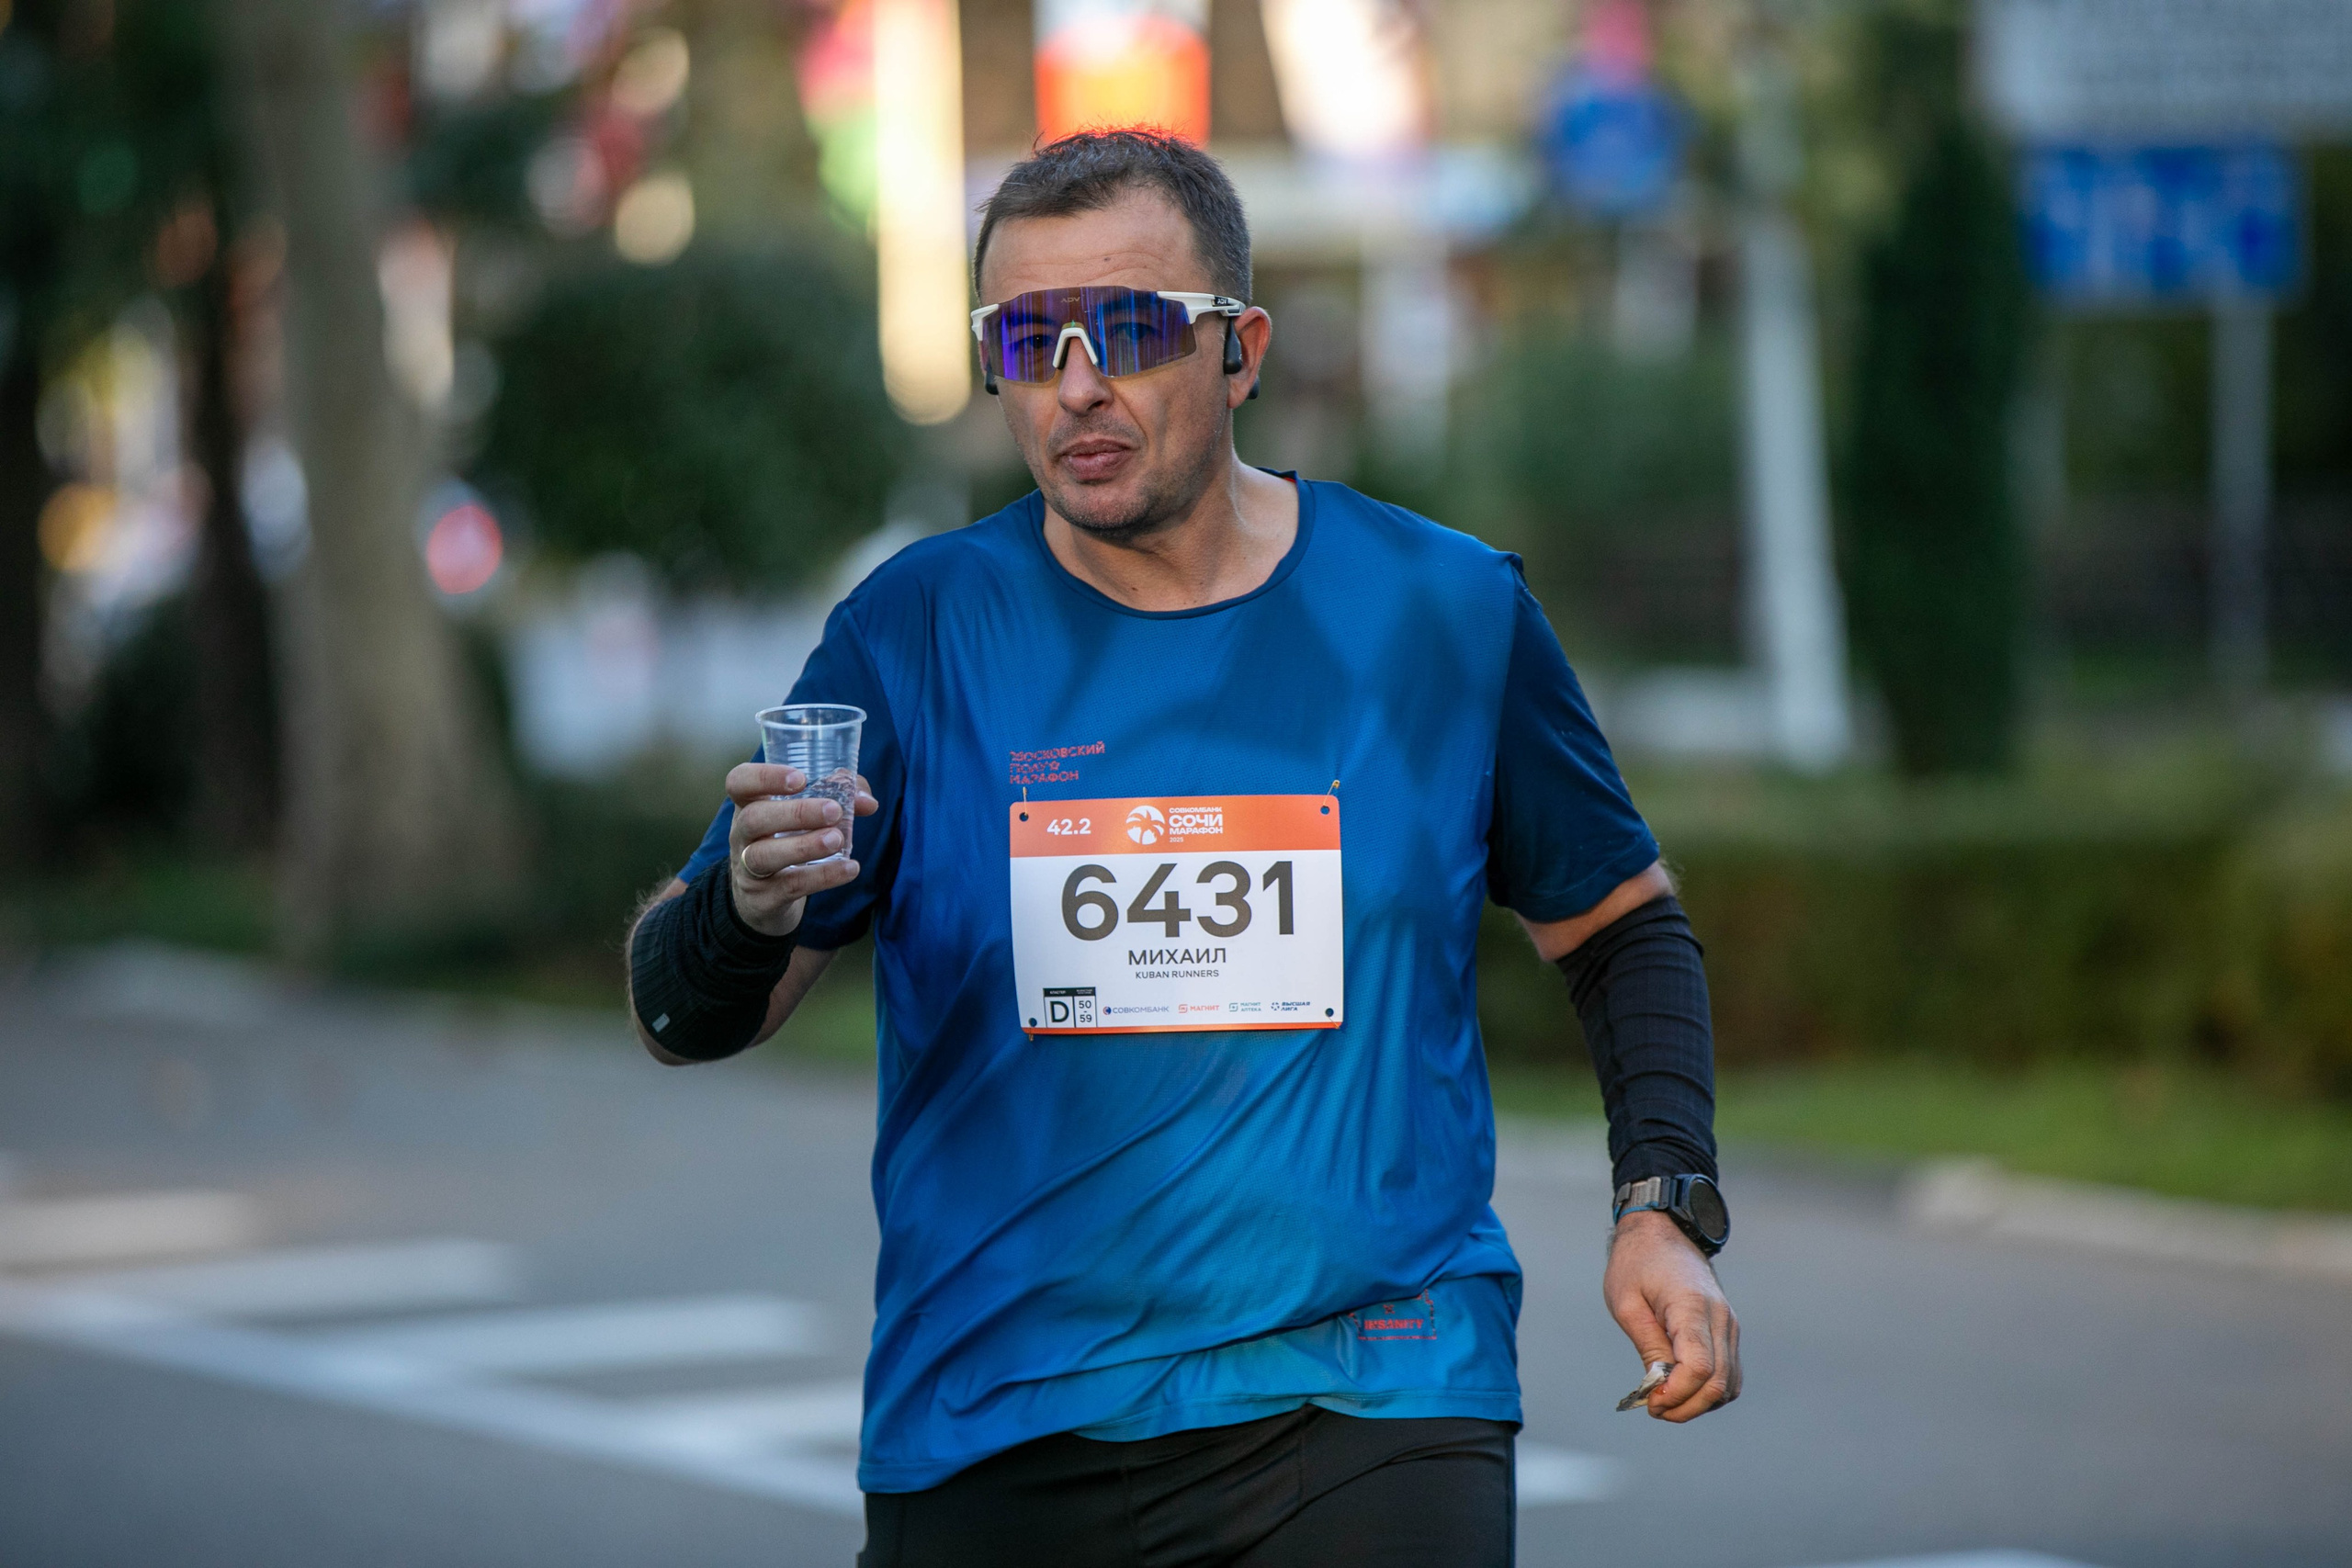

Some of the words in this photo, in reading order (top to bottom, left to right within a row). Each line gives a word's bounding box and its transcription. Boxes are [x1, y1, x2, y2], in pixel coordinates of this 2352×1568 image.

[1010, 770, 1080, 784] МАРАФОН
[1046, 818, 1091, 835] 42.2
[1169, 814, 1224, 828] СОЧИ
[1169, 827, 1224, 835] МАРАФОН
[1061, 860, 1295, 942] 6431
[1128, 948, 1227, 965] МИХАИЛ
[1136, 971, 1170, 979] KUBAN
[1171, 969, 1219, 978] RUNNERS
[1049, 1000, 1069, 1022] D
[1079, 1000, 1092, 1009] 50
[1113, 1006, 1170, 1014] СОВКОМБАНК
[1080, 1014, 1092, 1022] 59
